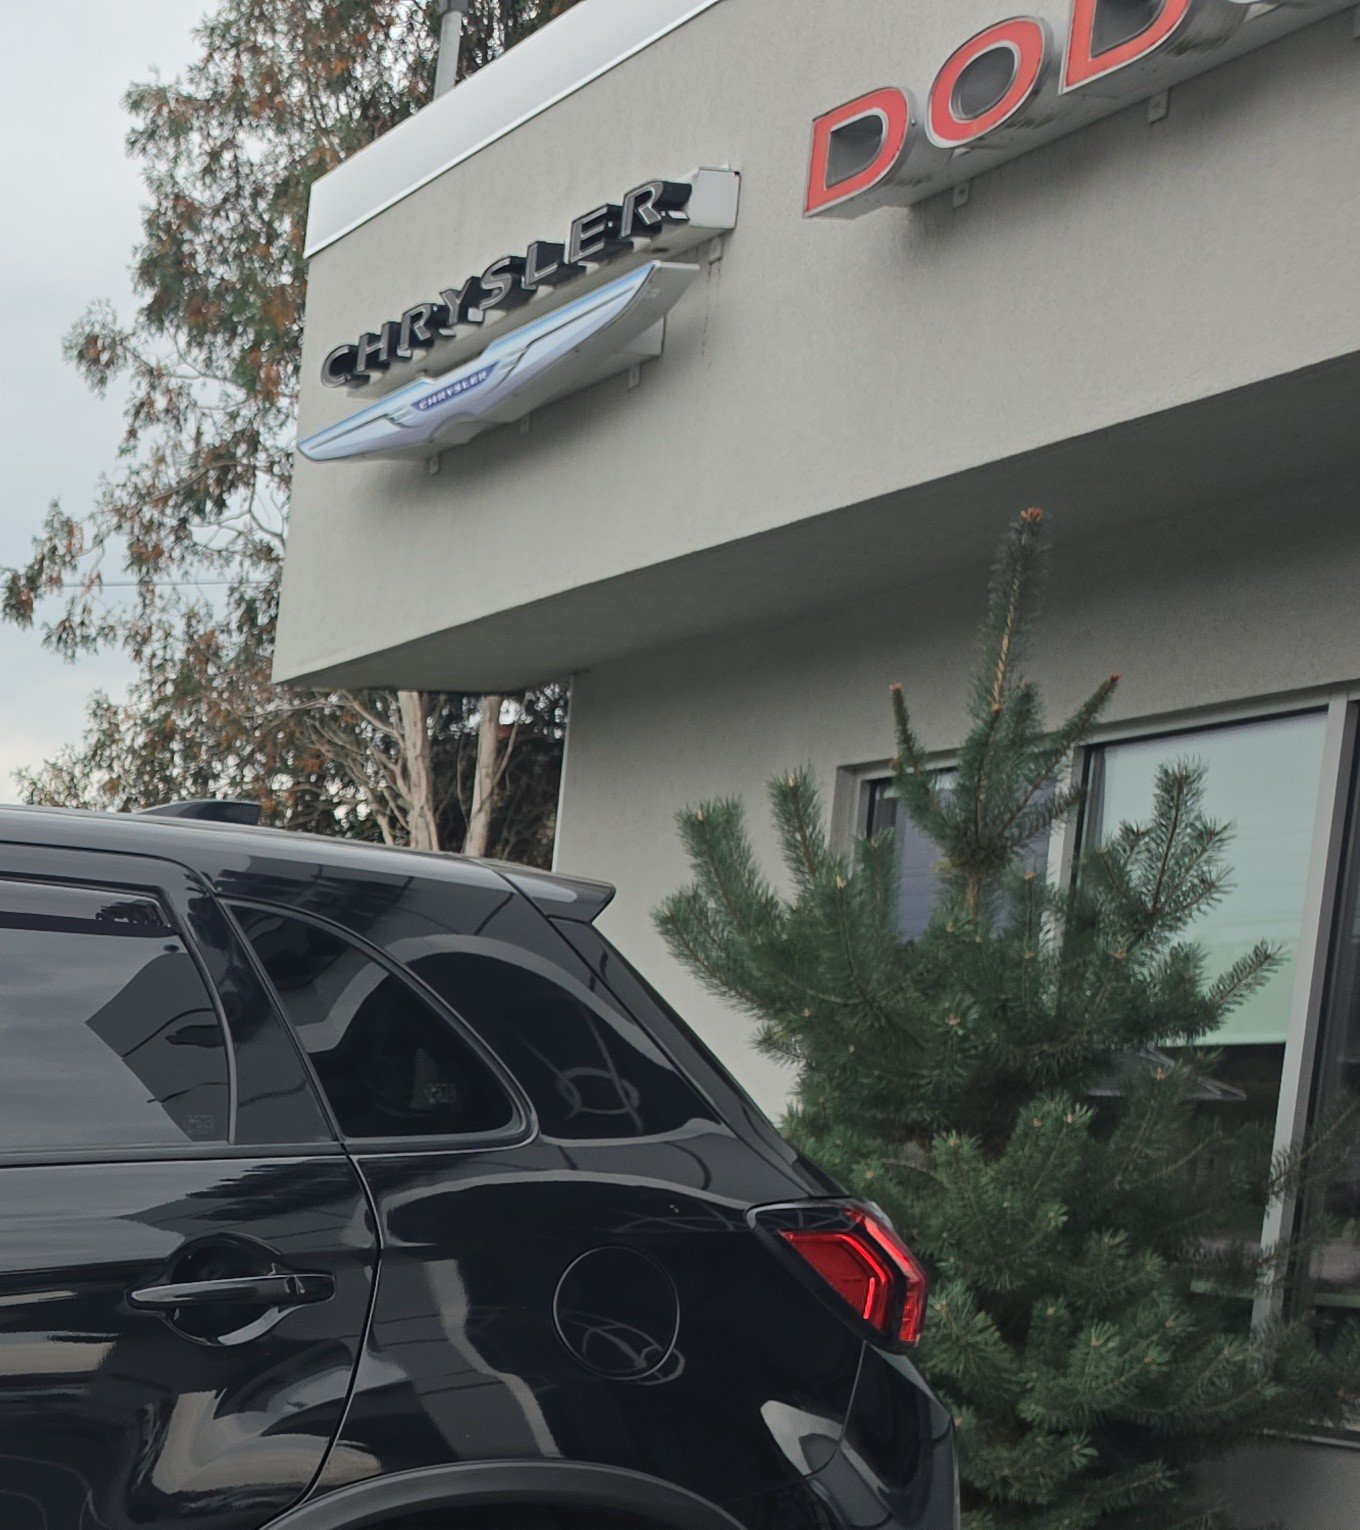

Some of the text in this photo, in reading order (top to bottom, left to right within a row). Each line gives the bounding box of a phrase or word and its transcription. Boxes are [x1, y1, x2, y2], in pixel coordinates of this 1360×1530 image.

[803, 0, 1258, 217] DOD
[321, 179, 666, 388] CHRYSLER
[417, 369, 489, 411] CHRYSLER
